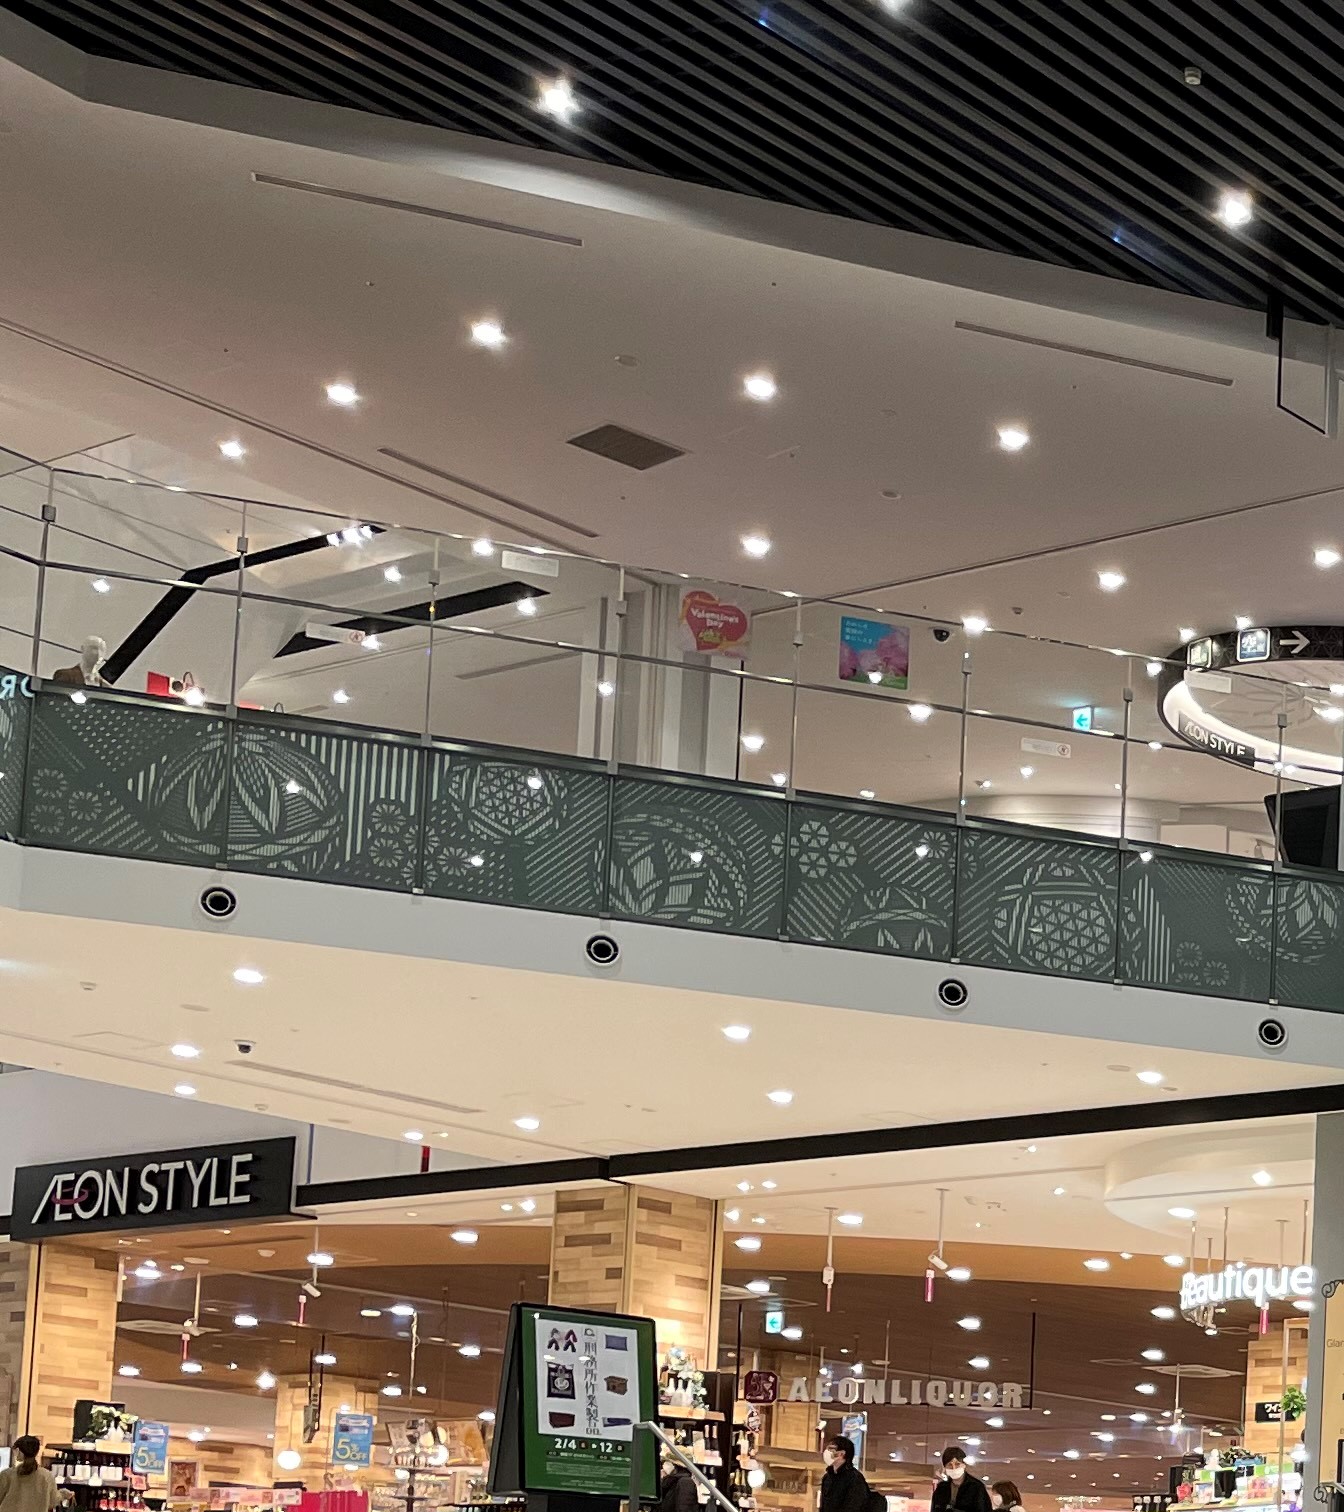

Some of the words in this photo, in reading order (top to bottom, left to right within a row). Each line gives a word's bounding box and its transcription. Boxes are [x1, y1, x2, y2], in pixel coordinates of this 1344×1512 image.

[137, 1153, 254, 1214] STYLE
[1180, 1261, 1314, 1312] Beautique
[554, 1437, 577, 1450] 2/4
[600, 1441, 613, 1453] 12
